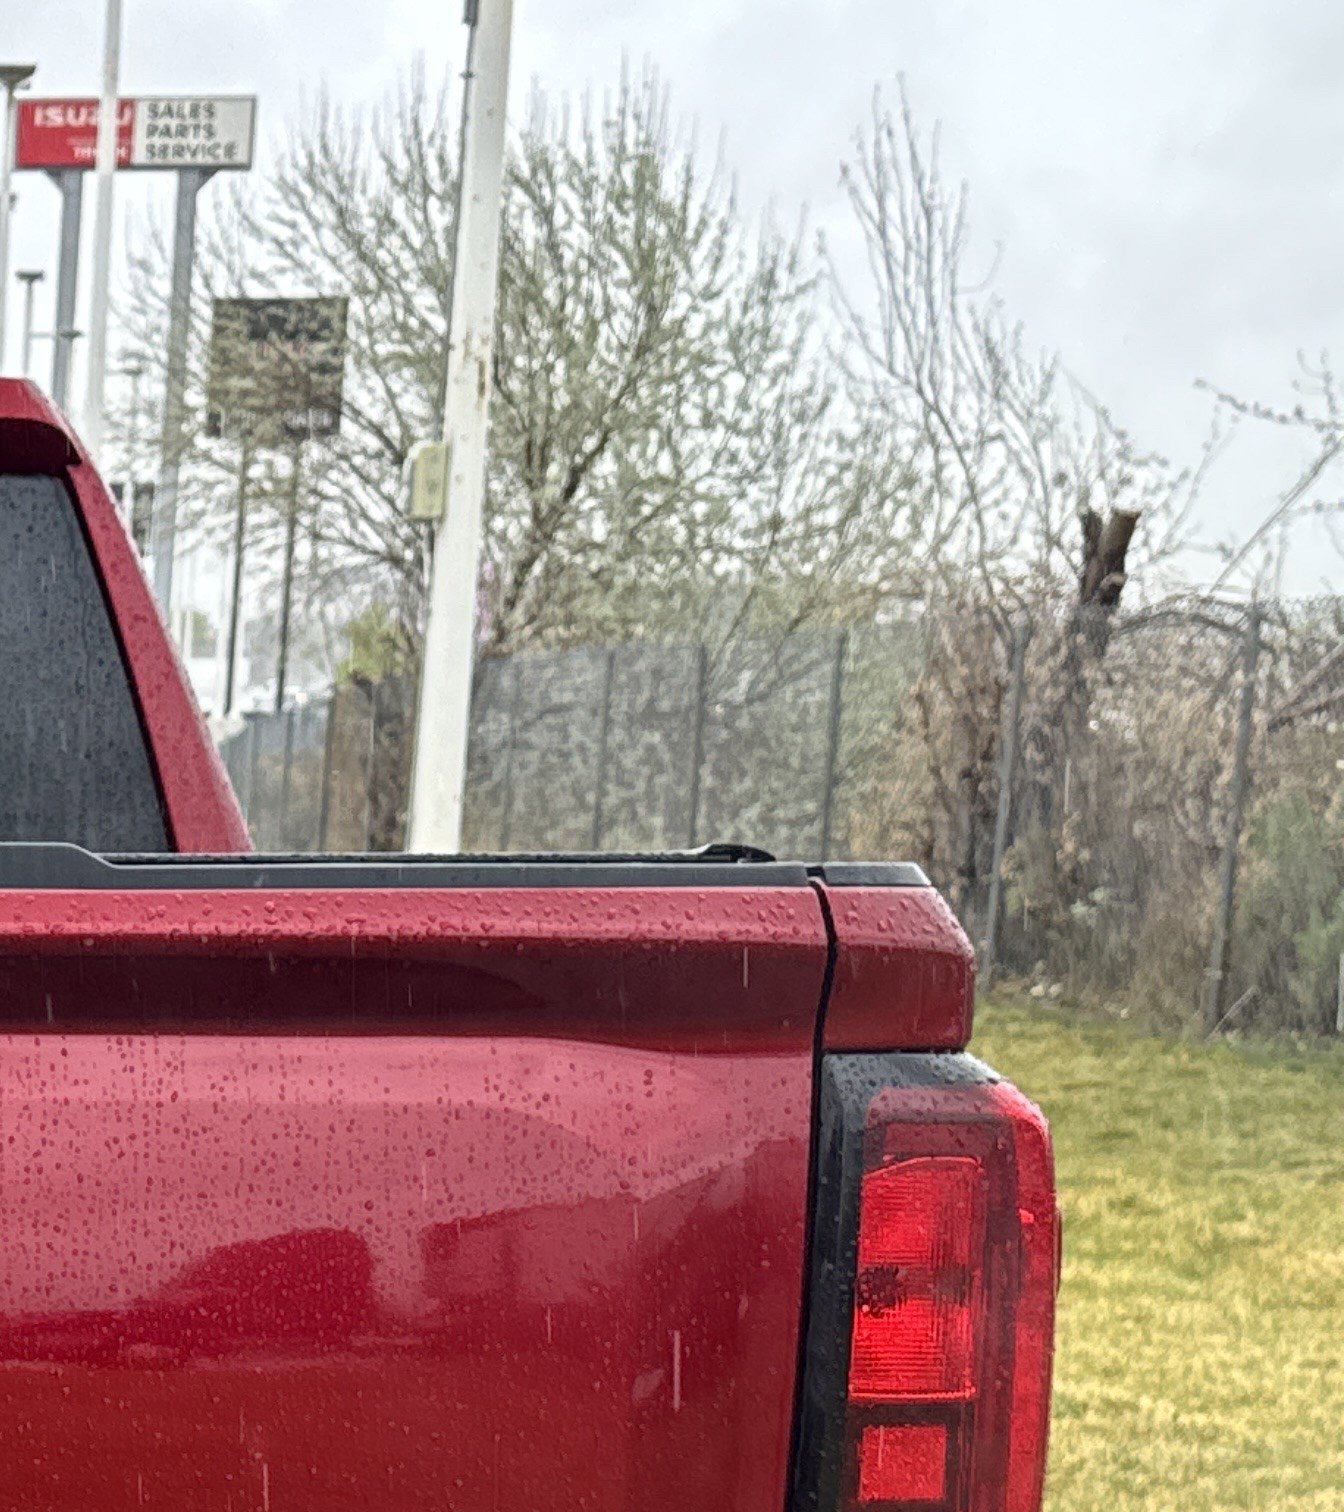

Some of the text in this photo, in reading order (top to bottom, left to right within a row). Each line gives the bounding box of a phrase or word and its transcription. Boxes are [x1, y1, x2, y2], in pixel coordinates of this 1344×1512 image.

[33, 105, 132, 128] ISUU
[147, 102, 216, 121] SALES
[145, 123, 215, 140] PARTS
[145, 142, 239, 161] SERVICE
